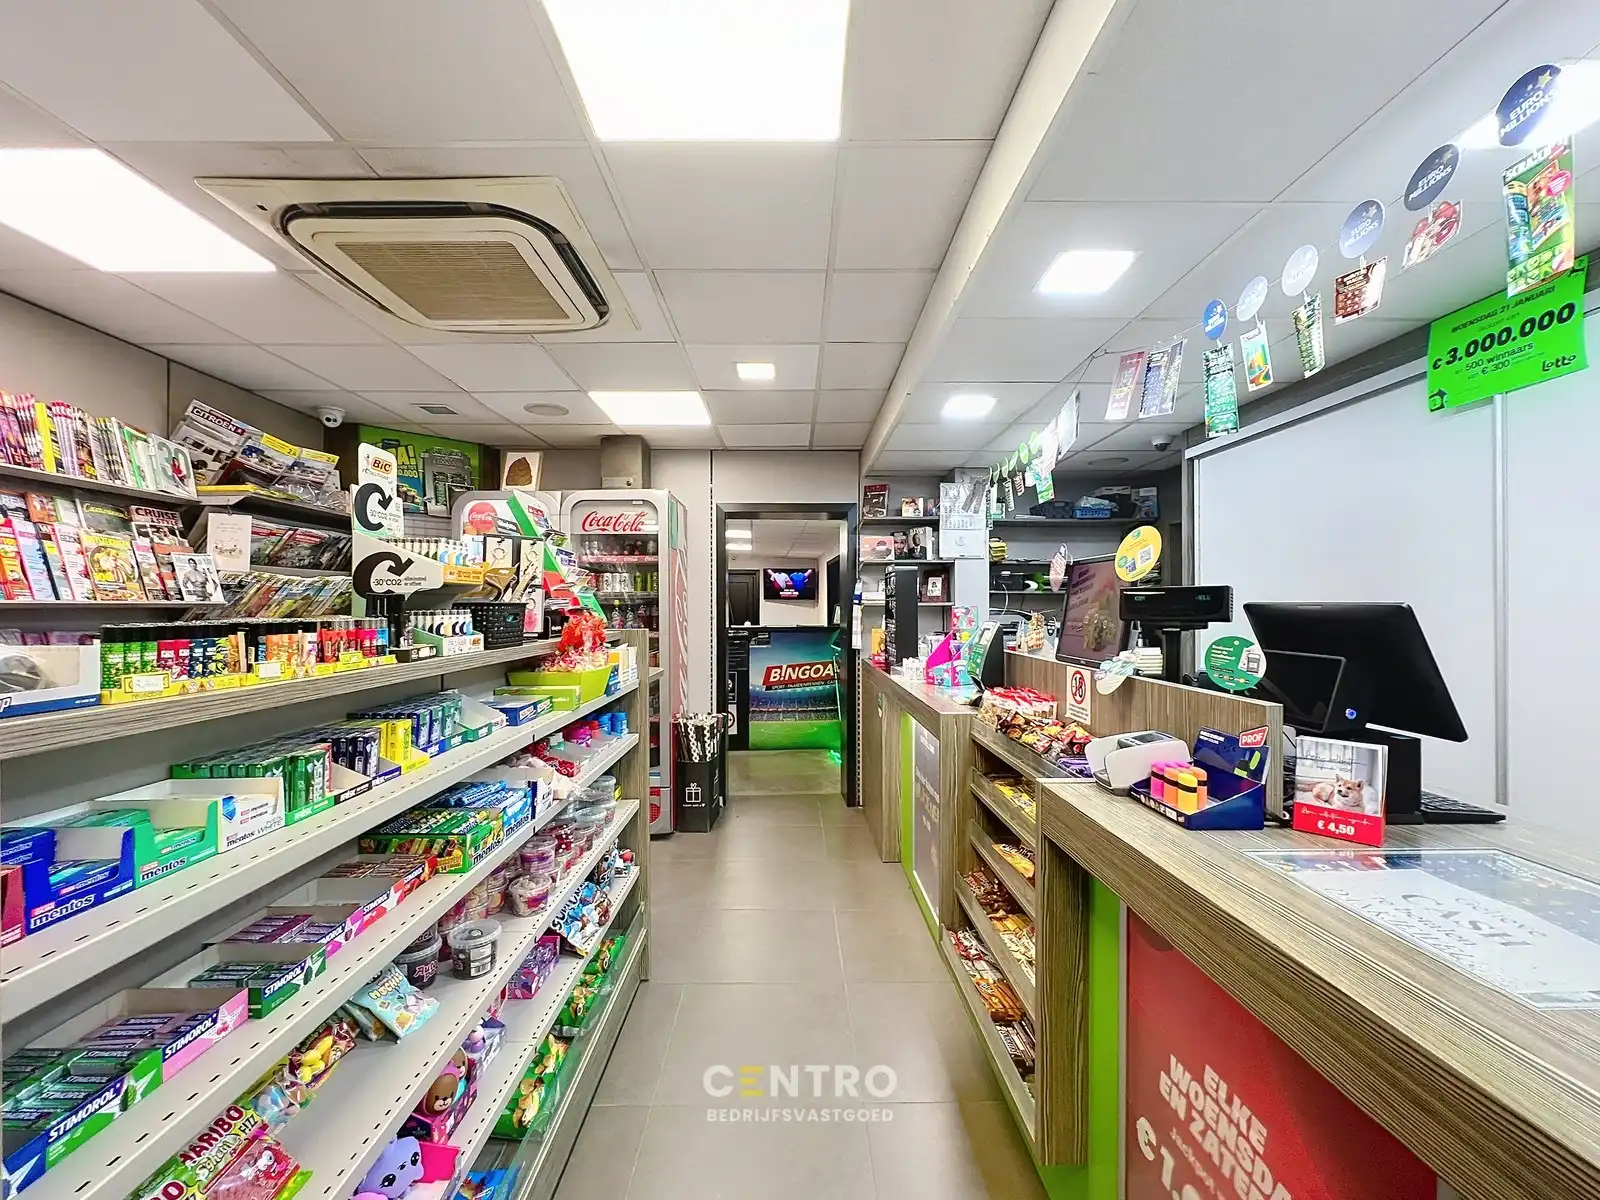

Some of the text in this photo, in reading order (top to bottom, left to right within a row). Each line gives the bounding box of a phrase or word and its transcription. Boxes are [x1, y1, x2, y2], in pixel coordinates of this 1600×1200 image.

[1408, 164, 1452, 203] MILLIONS
[1418, 164, 1444, 190] EURO
[1451, 309, 1498, 333] WOENSDAG
[1511, 285, 1556, 309] JANUARI
[1445, 302, 1576, 366] 3.000.000
[1465, 358, 1484, 371] 500
[1486, 342, 1534, 364] winnaars
[1491, 360, 1510, 373] 300
[192, 406, 237, 432] CITROËN
[135, 507, 178, 519] CRUISE
[1241, 732, 1264, 746] PROF
[226, 830, 256, 848] mentos
[1317, 819, 1356, 836] € 4,50
[140, 857, 187, 881] mentos
[31, 894, 96, 929] mentos
[264, 965, 306, 998] STIMOROL
[164, 1017, 214, 1059] STIMOROL
[1159, 1070, 1187, 1121] EN
[1203, 1063, 1267, 1155] ELKE
[48, 1088, 117, 1143] STIMOROL
